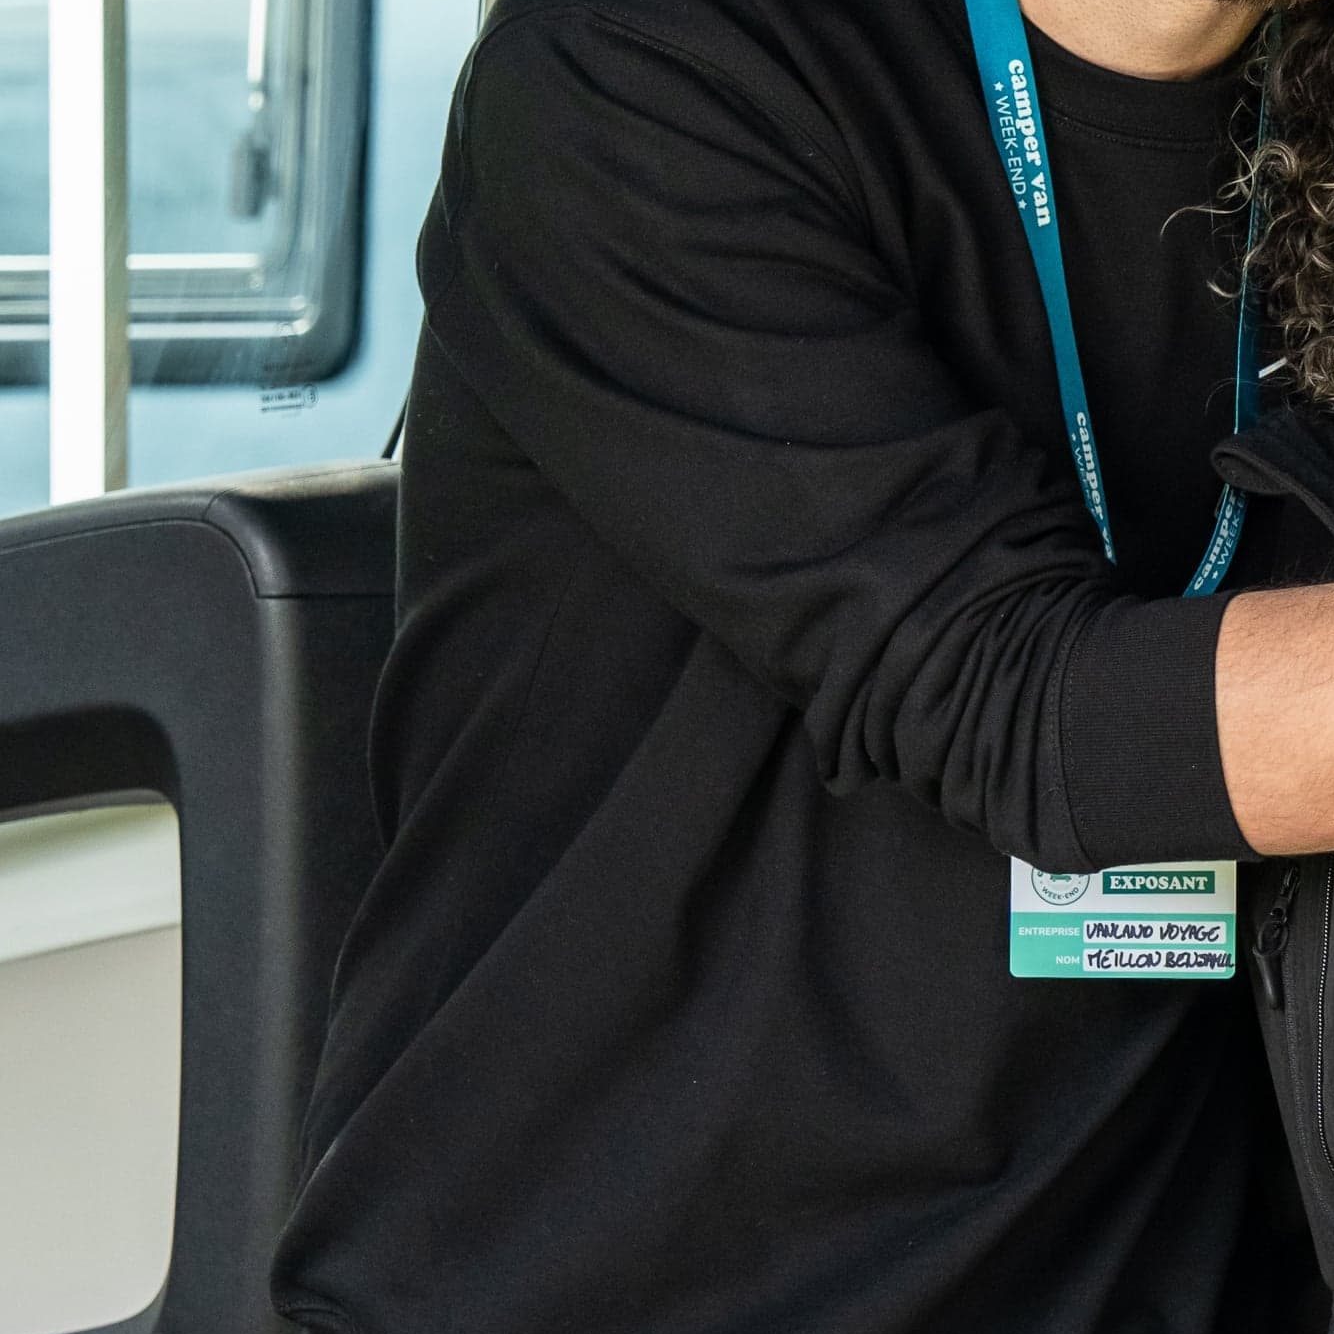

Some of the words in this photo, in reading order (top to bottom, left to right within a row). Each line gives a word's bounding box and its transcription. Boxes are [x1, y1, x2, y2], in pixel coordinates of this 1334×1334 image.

[995, 95, 1027, 195] WEEK-END
[1008, 59, 1042, 167] camper
[1031, 171, 1051, 228] van
[1076, 411, 1104, 520] camper
[1193, 488, 1237, 591] camper
[1109, 875, 1209, 891] EXPOSANT
[1018, 926, 1081, 936] ENTREPRISE
[1055, 954, 1081, 965] NOM
[1159, 923, 1221, 942] VOYAGE
